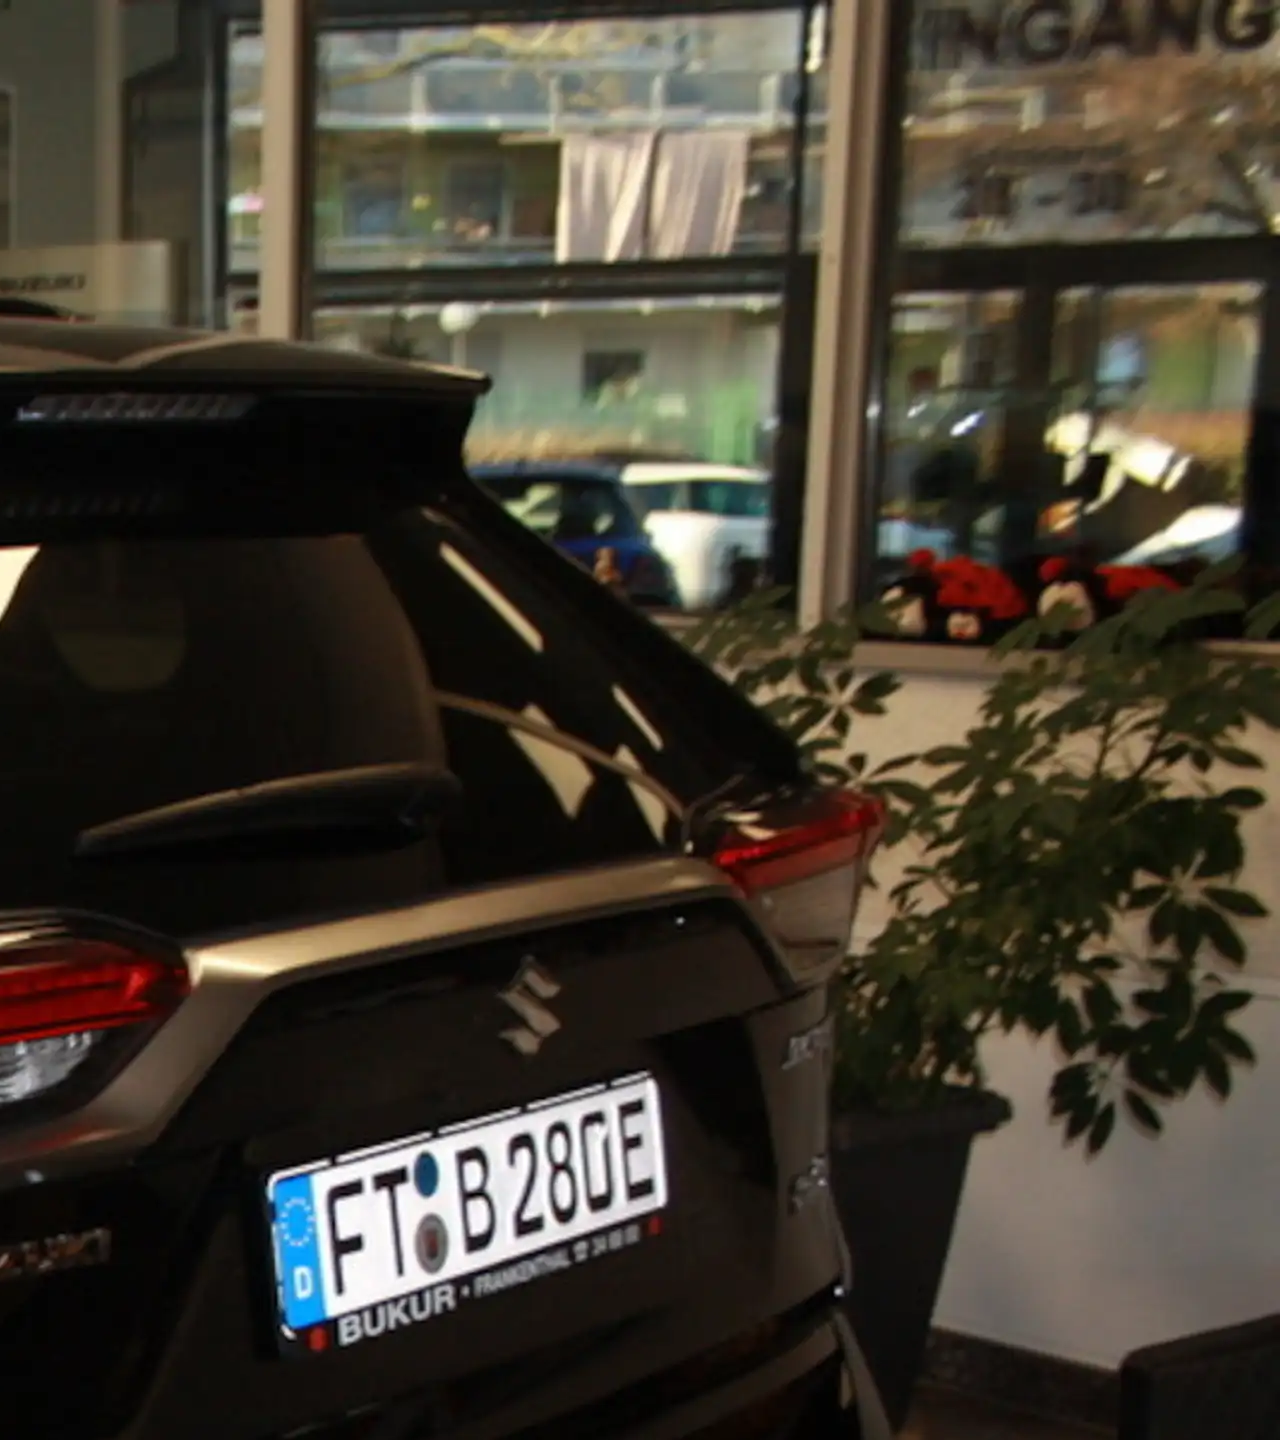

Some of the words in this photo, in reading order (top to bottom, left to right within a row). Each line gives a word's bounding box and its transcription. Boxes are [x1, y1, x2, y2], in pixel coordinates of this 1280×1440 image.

[326, 1165, 409, 1297] FT
[454, 1146, 498, 1254] B
[506, 1097, 656, 1240] 280E
[292, 1263, 314, 1300] D
[337, 1282, 458, 1348] BUKUR
